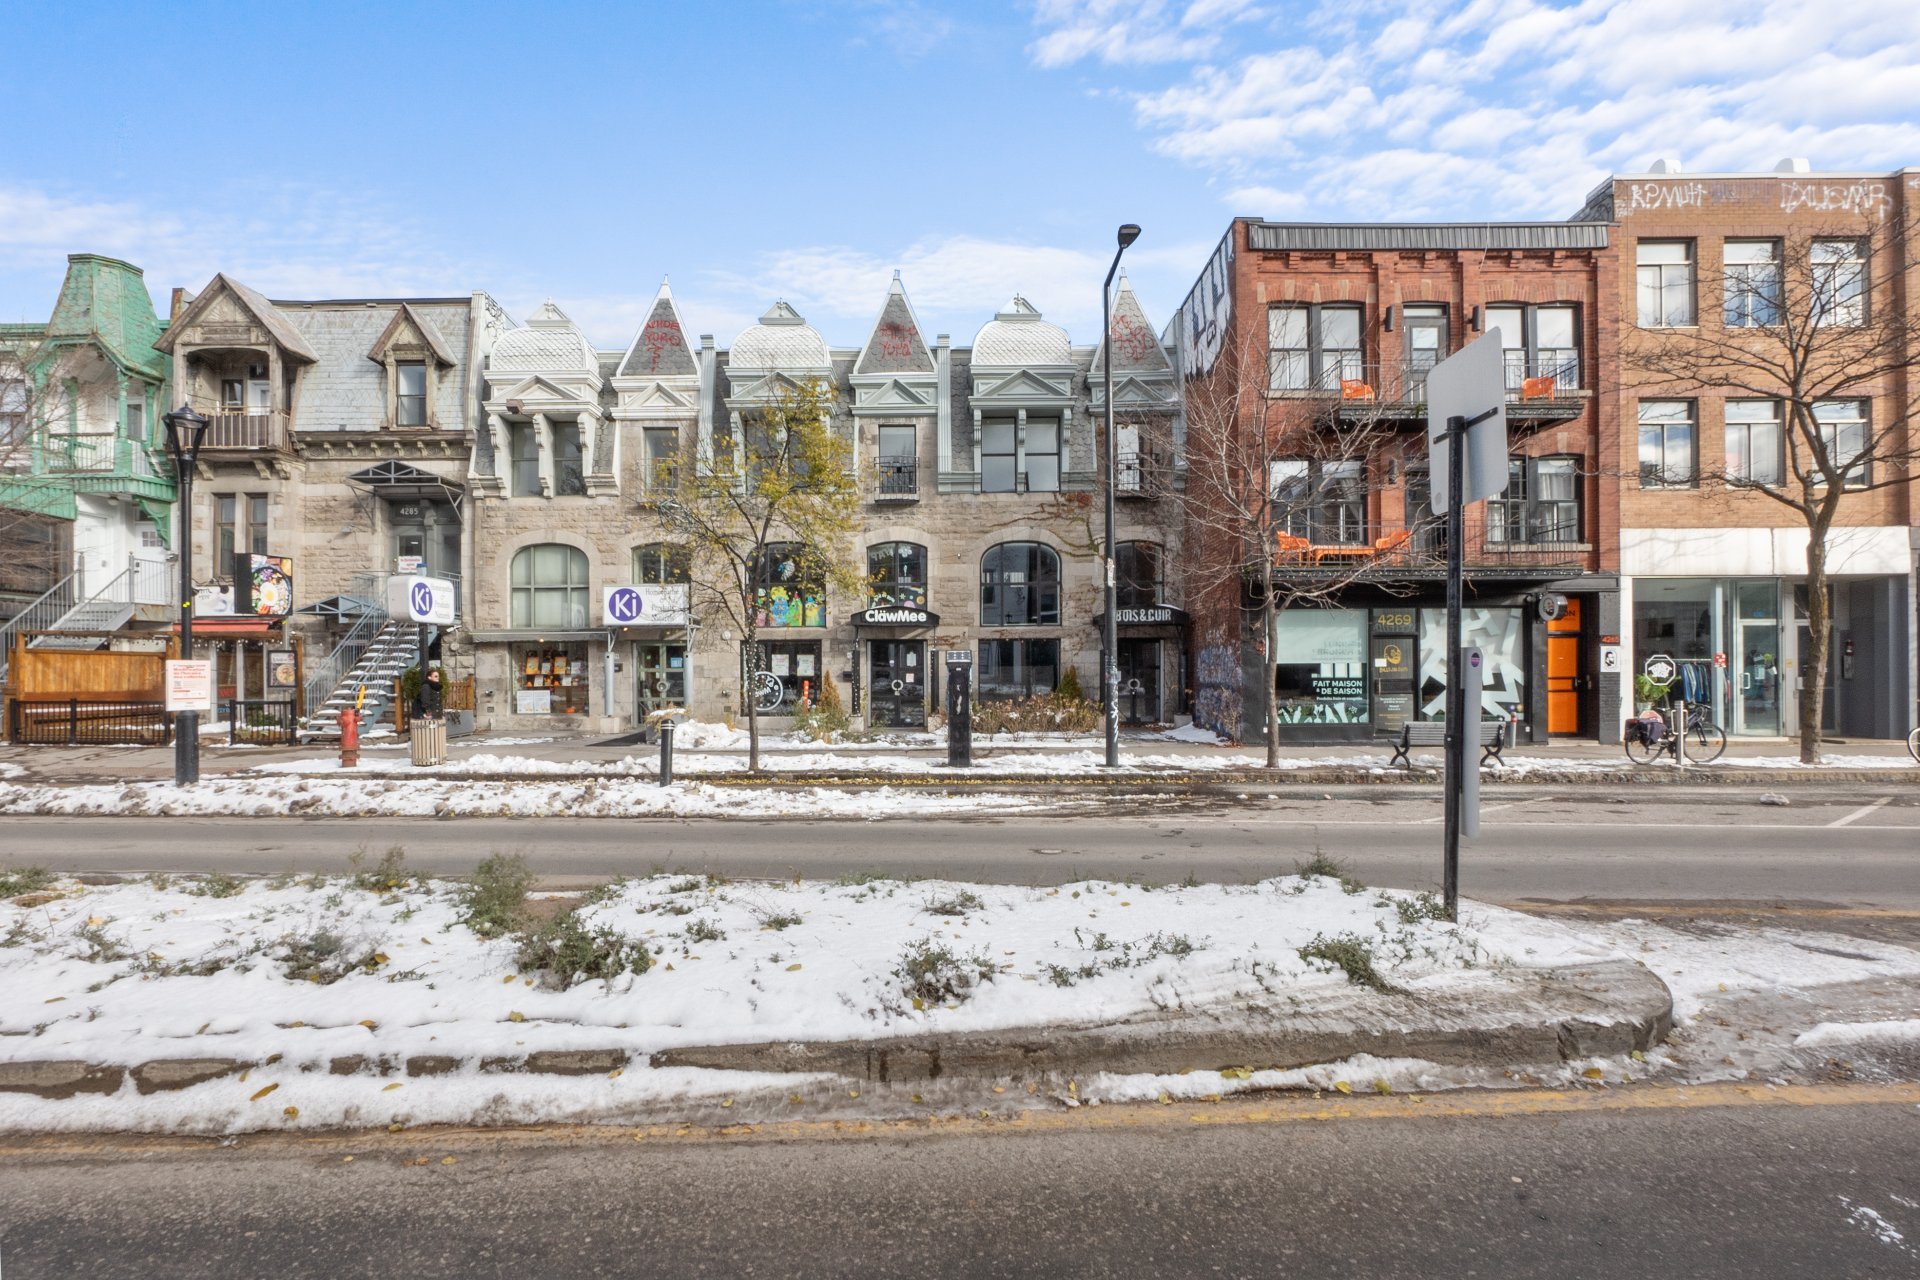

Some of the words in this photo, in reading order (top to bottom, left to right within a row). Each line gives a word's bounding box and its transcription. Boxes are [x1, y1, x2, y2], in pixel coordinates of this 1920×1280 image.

[400, 507, 419, 515] 4285
[414, 586, 430, 612] Ki
[615, 592, 637, 617] Ki
[865, 610, 927, 622] CläwMee
[1378, 614, 1412, 625] 4269
[1321, 687, 1332, 695] DE
[1333, 687, 1363, 695] SAISON
